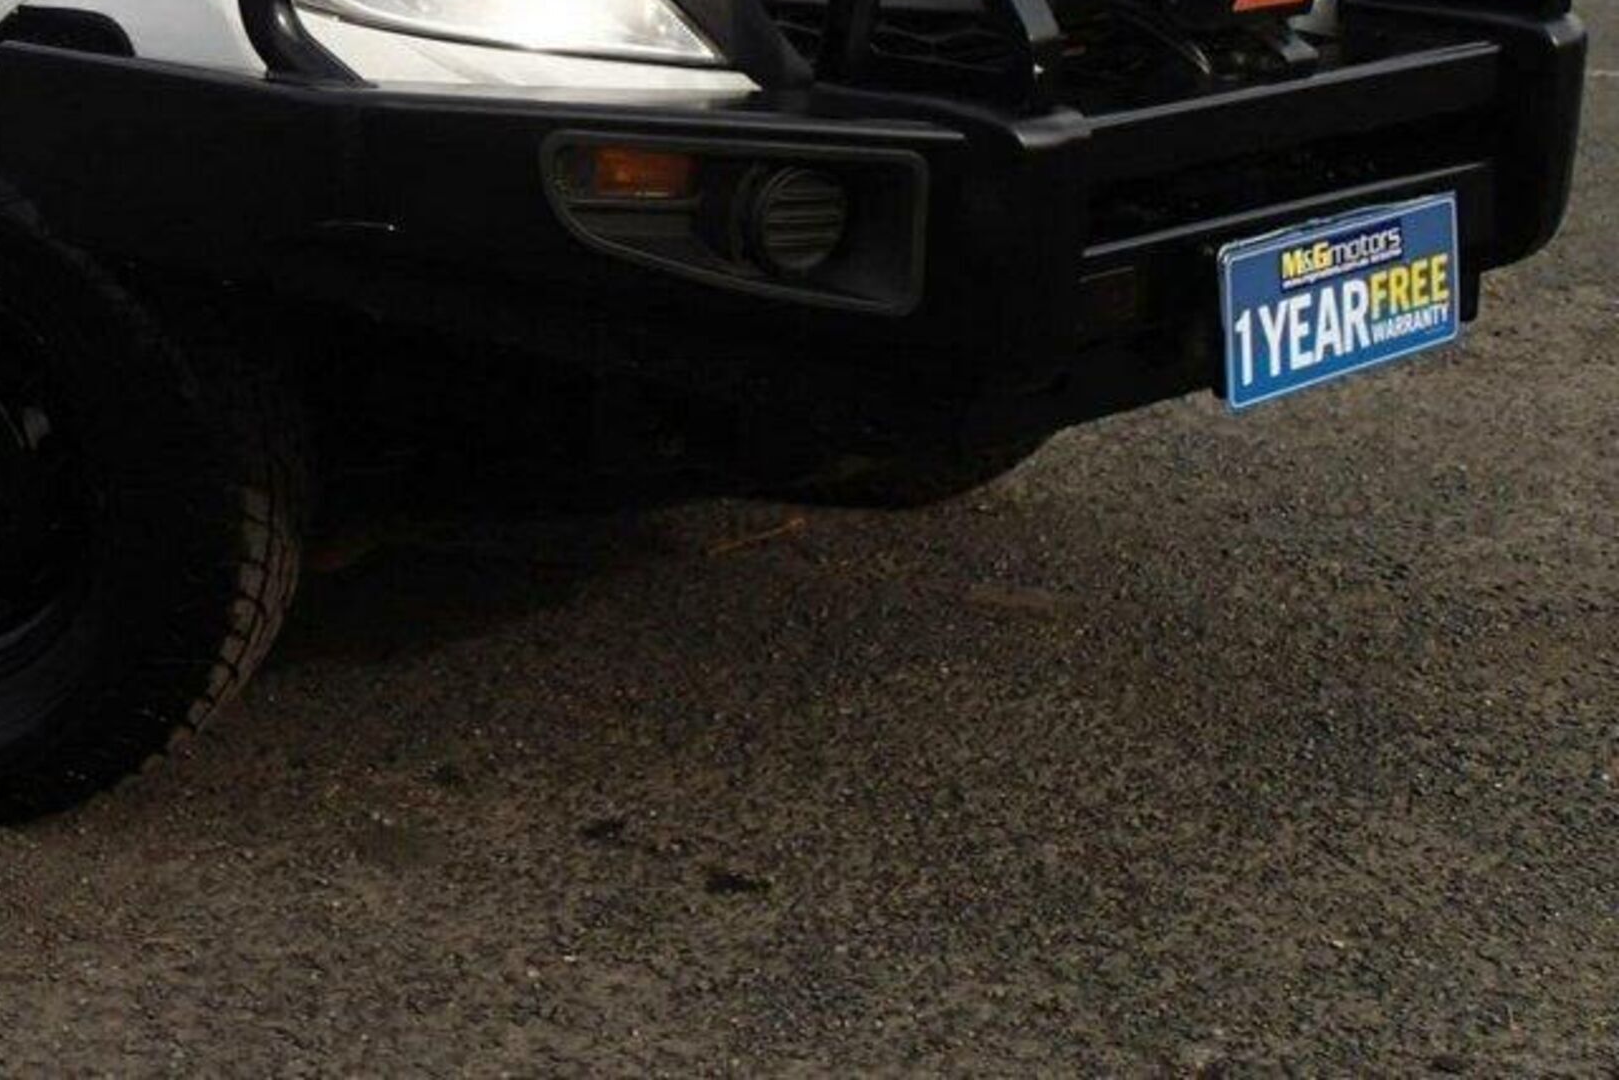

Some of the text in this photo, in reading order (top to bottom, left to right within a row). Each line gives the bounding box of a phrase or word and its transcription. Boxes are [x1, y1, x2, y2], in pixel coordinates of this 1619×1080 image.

[1258, 278, 1371, 378] YEAR
[1369, 254, 1450, 320] FREE
[1372, 302, 1450, 344] WARRANTY
